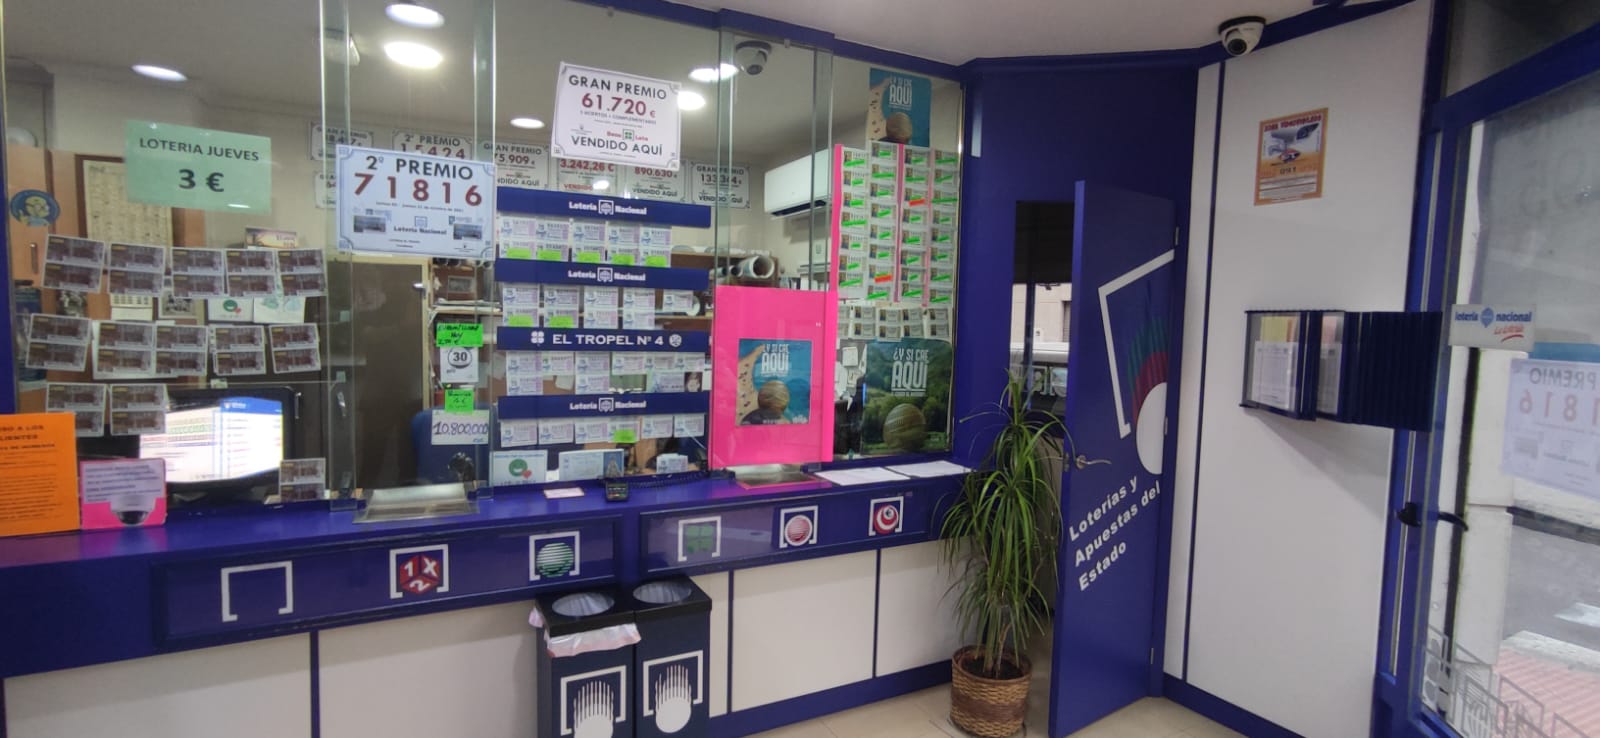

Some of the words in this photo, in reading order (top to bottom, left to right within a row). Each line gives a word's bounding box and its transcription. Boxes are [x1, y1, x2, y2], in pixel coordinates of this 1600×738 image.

[569, 75, 610, 92] GRAN
[616, 82, 667, 100] PREMIO
[581, 92, 647, 117] 61.720
[649, 109, 656, 118] €
[139, 137, 203, 155] LOTERIA
[207, 145, 260, 162] JUEVES
[420, 135, 460, 147] PREMIO
[571, 135, 628, 151] VENDIDO
[632, 143, 663, 156] AQUÍ
[396, 158, 473, 180] PREMIO
[178, 169, 196, 189] 3
[205, 172, 225, 193] €
[552, 334, 572, 344] EL
[575, 334, 634, 345] TROPEL
[654, 336, 664, 345] 4
[453, 352, 467, 361] 30
[906, 349, 913, 360] SI
[1129, 475, 1137, 493] y
[1075, 503, 1138, 567] Apuestas
[1141, 479, 1160, 506] del
[1079, 542, 1126, 591] Estado
